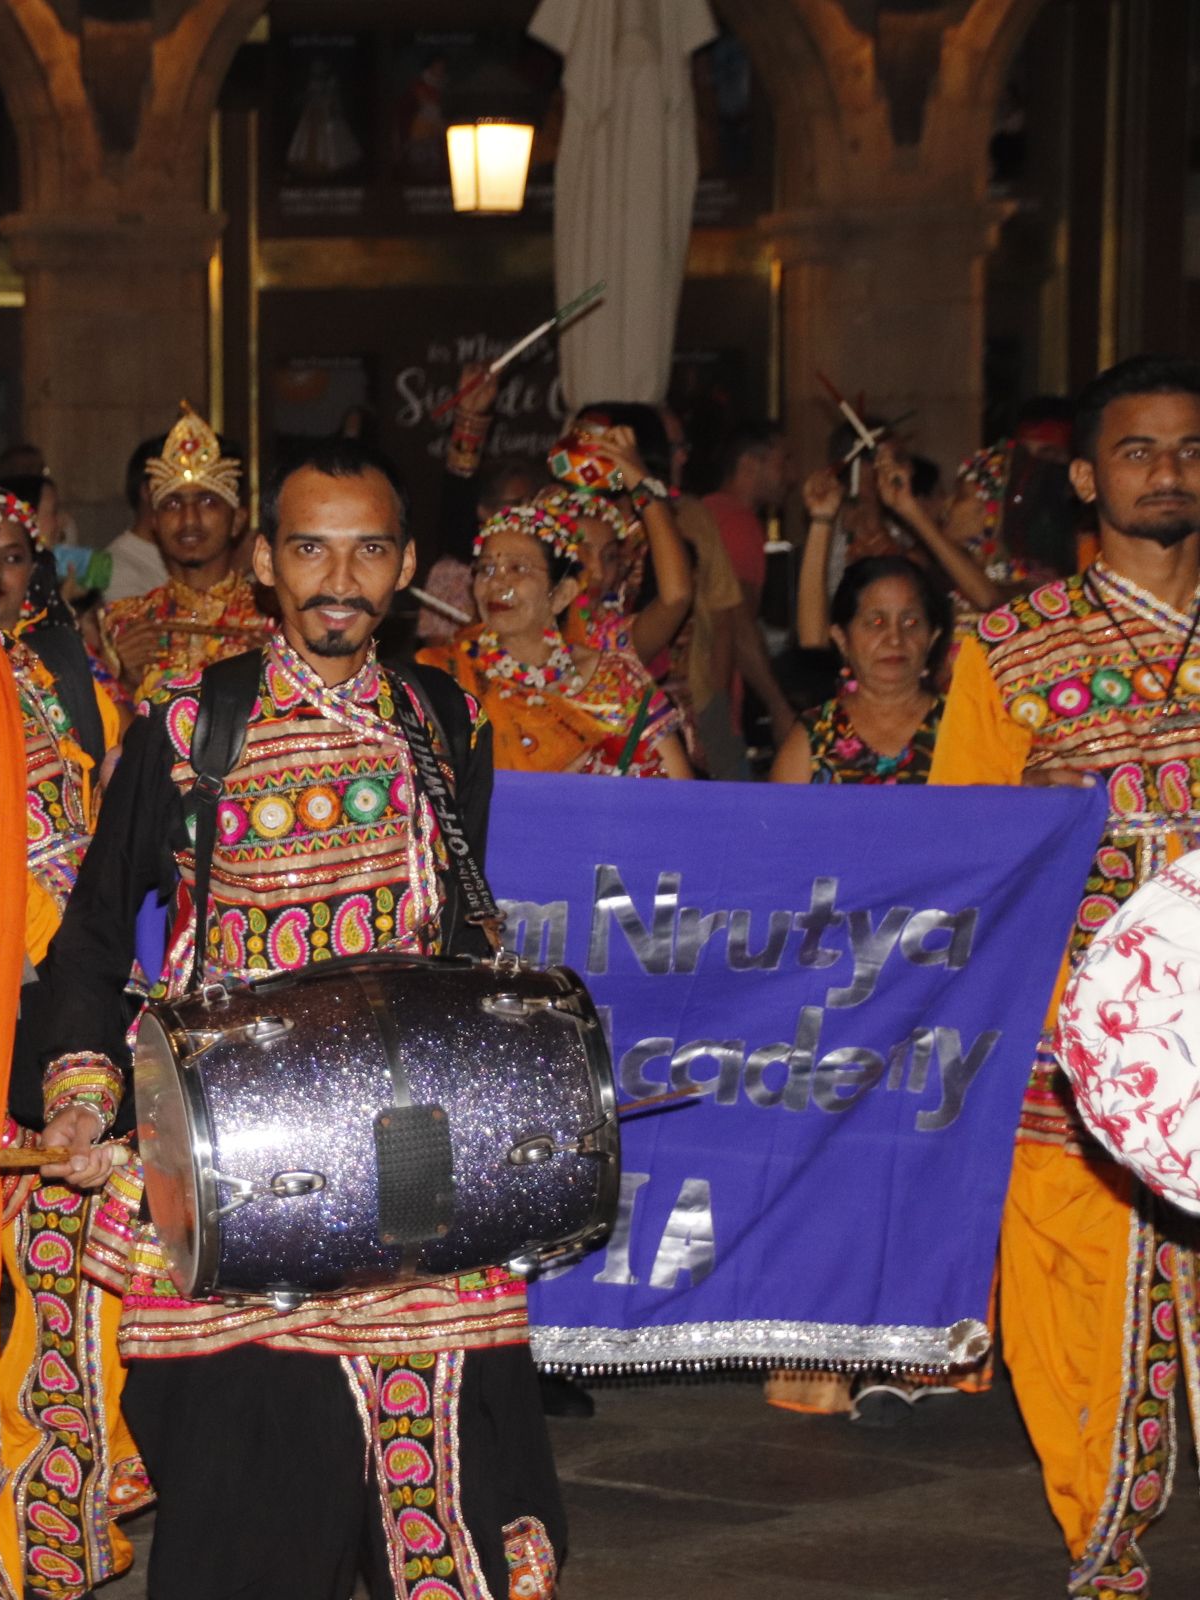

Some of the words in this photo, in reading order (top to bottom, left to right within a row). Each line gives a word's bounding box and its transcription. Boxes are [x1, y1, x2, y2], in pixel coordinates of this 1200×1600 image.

[400, 711, 470, 857] OFF-WHITE
[497, 899, 568, 968] m
[585, 864, 979, 1009] Nrutya
[596, 1005, 1002, 1132] cademy
[538, 1171, 717, 1290] IA
